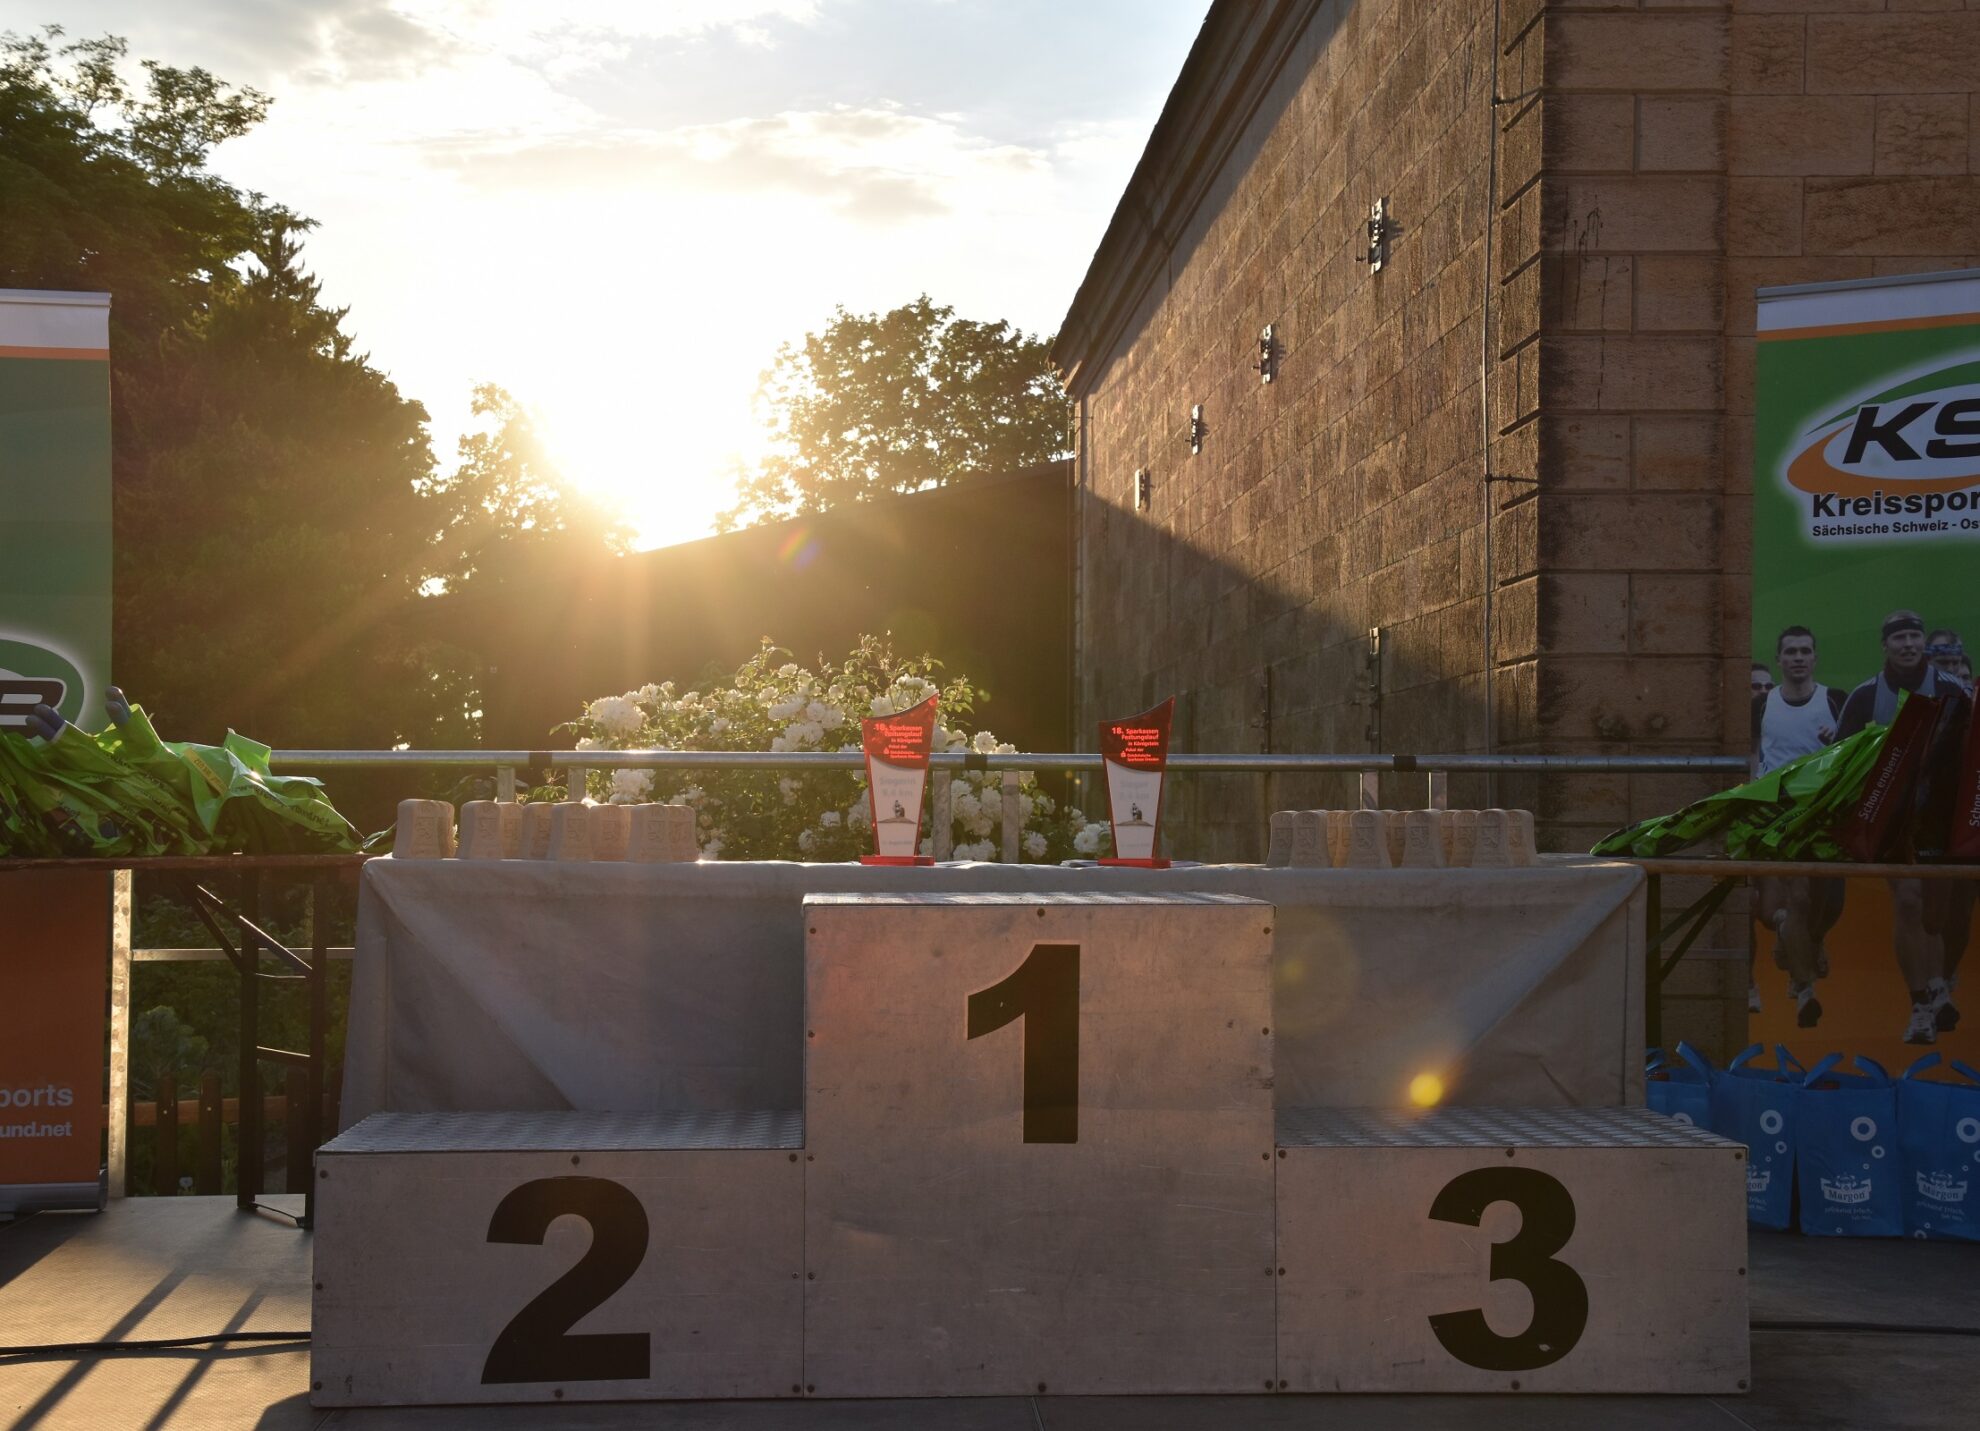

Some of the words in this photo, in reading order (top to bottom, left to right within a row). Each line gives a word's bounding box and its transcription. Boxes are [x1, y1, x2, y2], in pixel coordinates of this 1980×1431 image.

[1813, 525, 1889, 537] Sächsische
[1893, 520, 1948, 533] Schweiz
[1858, 790, 1881, 821] Schon
[1876, 746, 1902, 788] erobert?
[968, 945, 1080, 1144] 1
[1828, 1190, 1865, 1203] Margon
[481, 1175, 650, 1384] 2
[1428, 1166, 1589, 1372] 3
